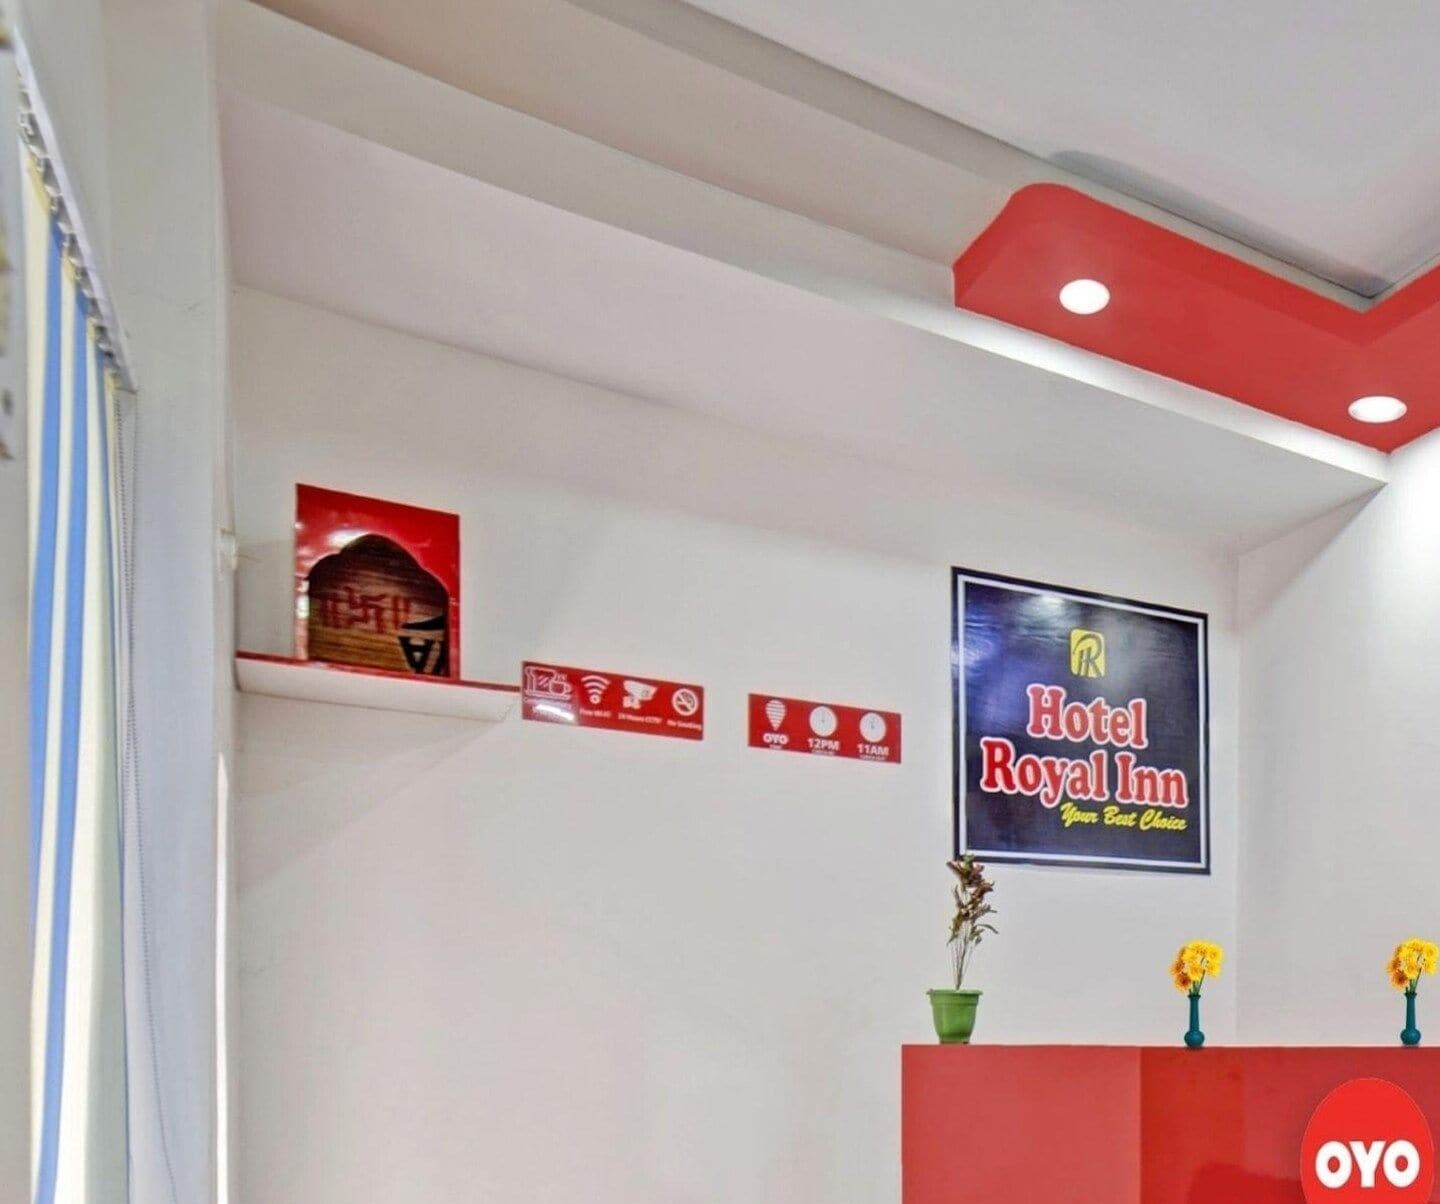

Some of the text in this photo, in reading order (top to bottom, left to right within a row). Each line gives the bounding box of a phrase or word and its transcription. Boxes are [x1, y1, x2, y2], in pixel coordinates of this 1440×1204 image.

[1027, 684, 1148, 748] Hotel
[762, 733, 789, 745] OYO
[807, 738, 840, 751] 12PM
[857, 743, 889, 756] 11AM
[980, 737, 1189, 808] Royal Inn
[1060, 802, 1188, 831] Your Best Choice
[1315, 1140, 1420, 1188] OYO
